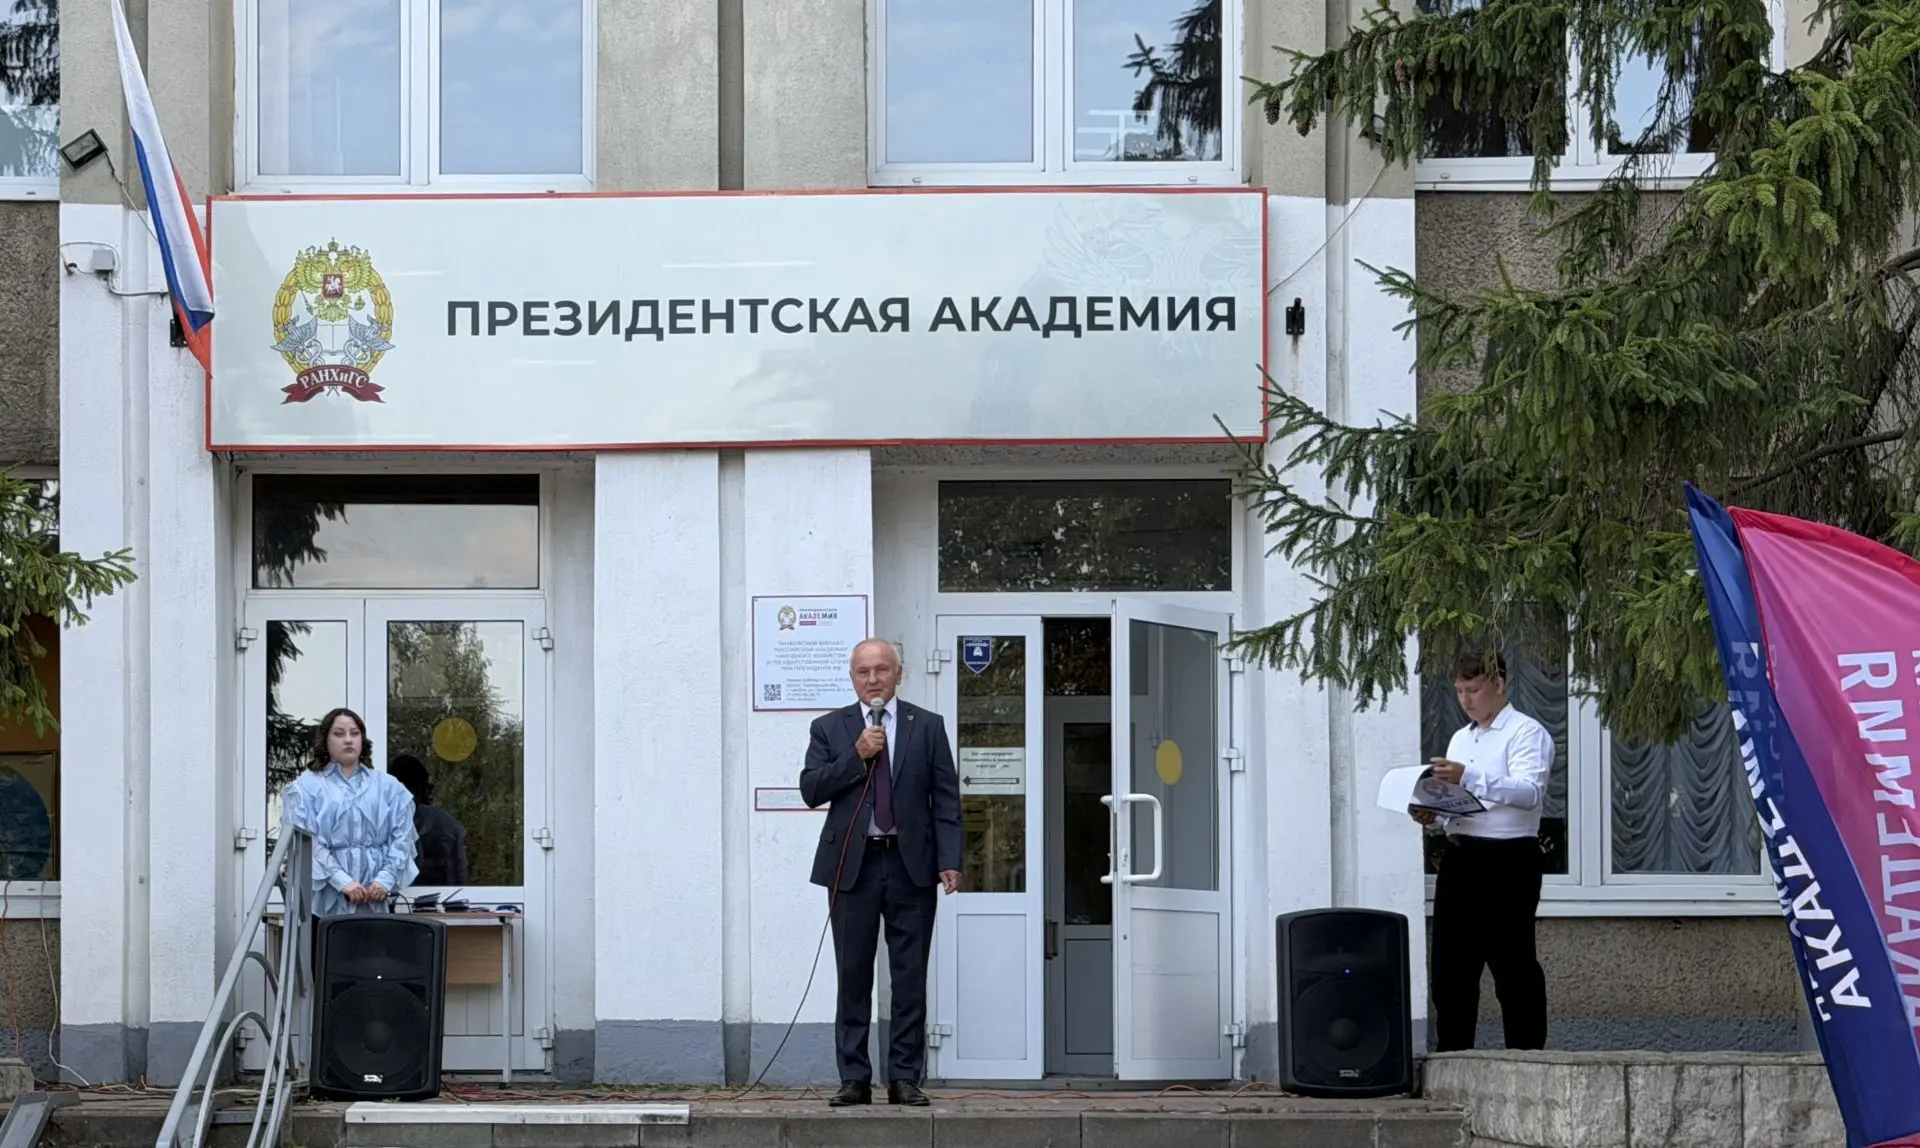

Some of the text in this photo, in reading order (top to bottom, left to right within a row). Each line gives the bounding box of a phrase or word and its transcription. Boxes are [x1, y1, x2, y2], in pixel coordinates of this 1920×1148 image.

[446, 296, 1236, 342] ПРЕЗИДЕНТСКАЯ АКАДЕМИЯ
[299, 368, 367, 389] РАНХиГС
